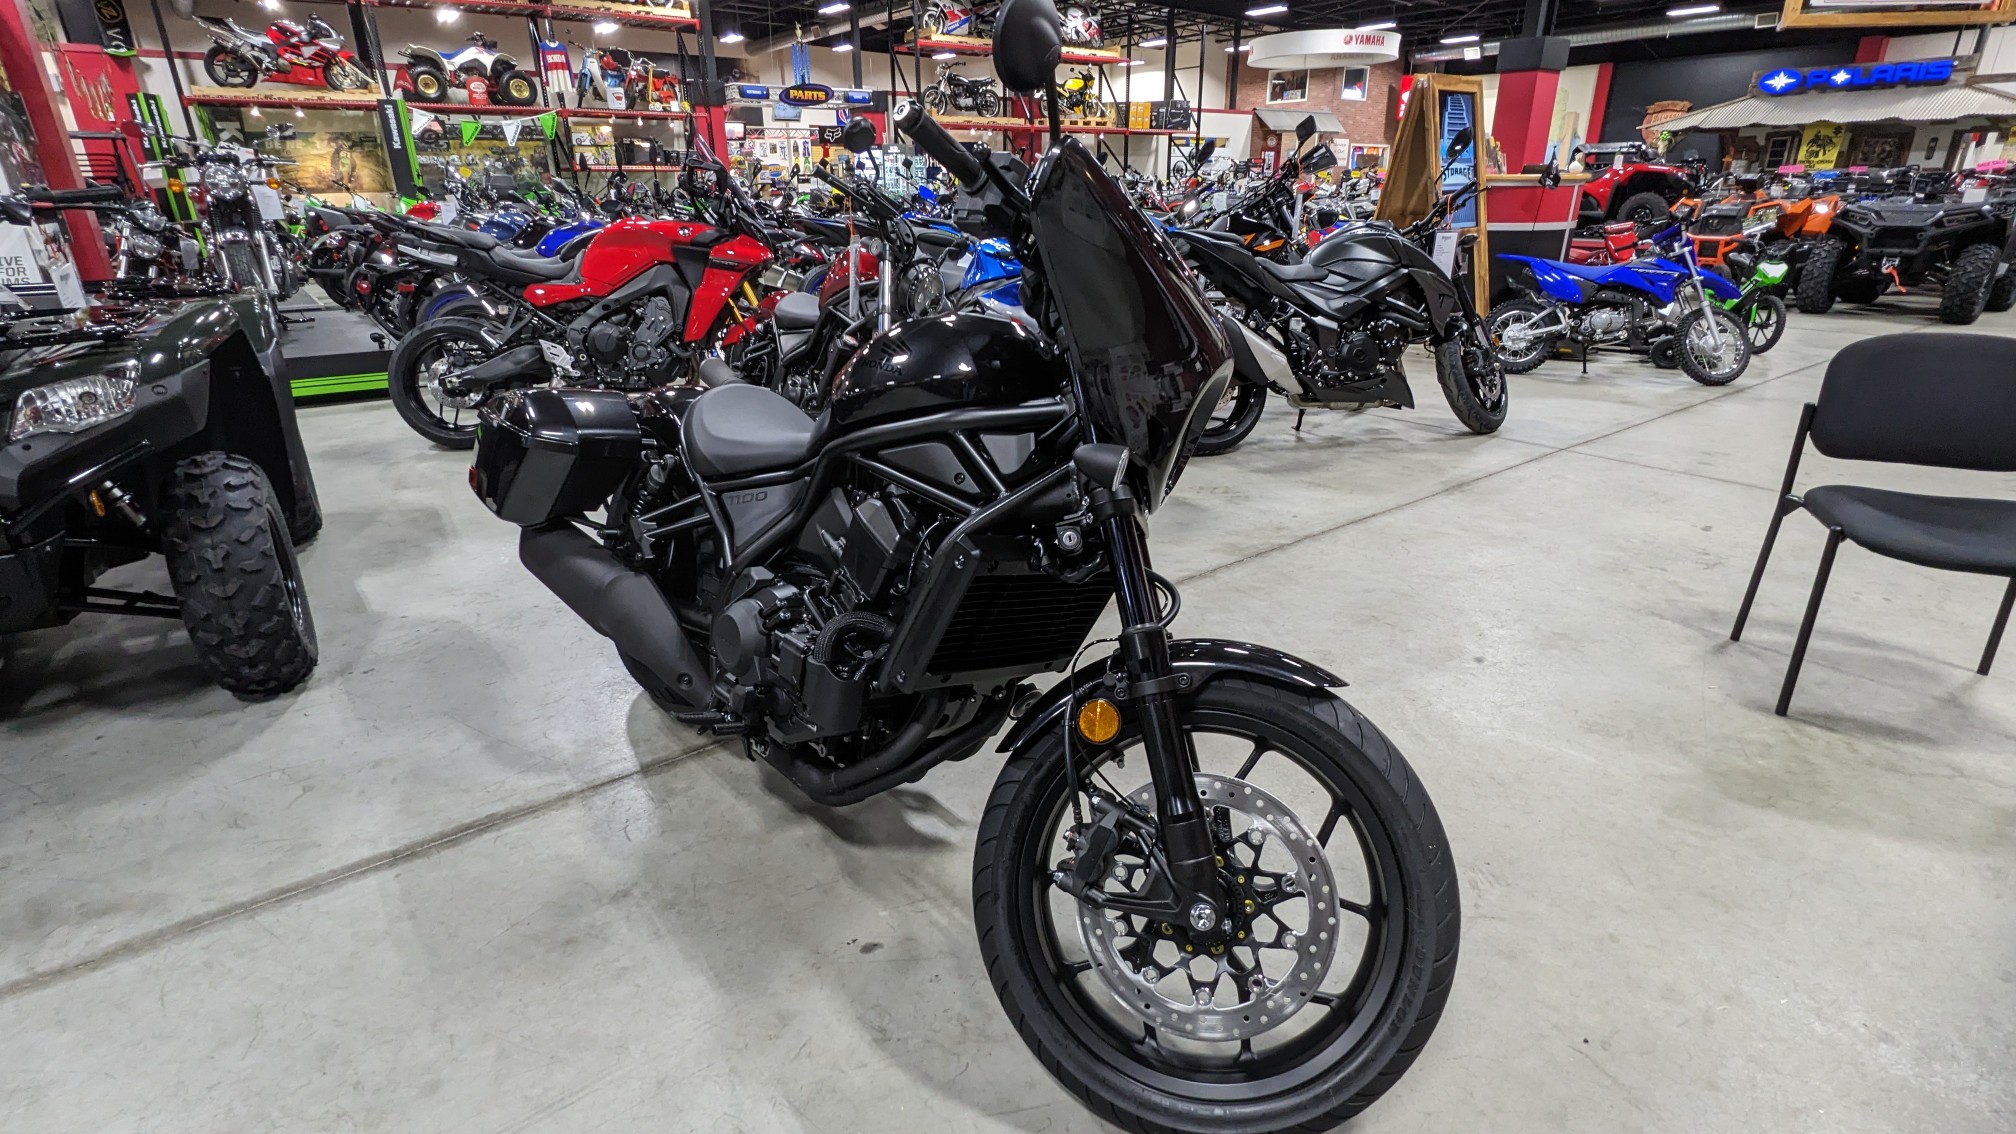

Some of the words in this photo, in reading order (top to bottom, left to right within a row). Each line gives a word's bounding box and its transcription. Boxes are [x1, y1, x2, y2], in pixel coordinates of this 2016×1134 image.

[1354, 34, 1385, 47] YAMAHA
[1806, 59, 1954, 88] POLARIS
[789, 89, 827, 101] PARTS
[384, 104, 402, 149] Kawasaki
[1442, 167, 1472, 182] STORAGE
[728, 490, 769, 506] 1100
